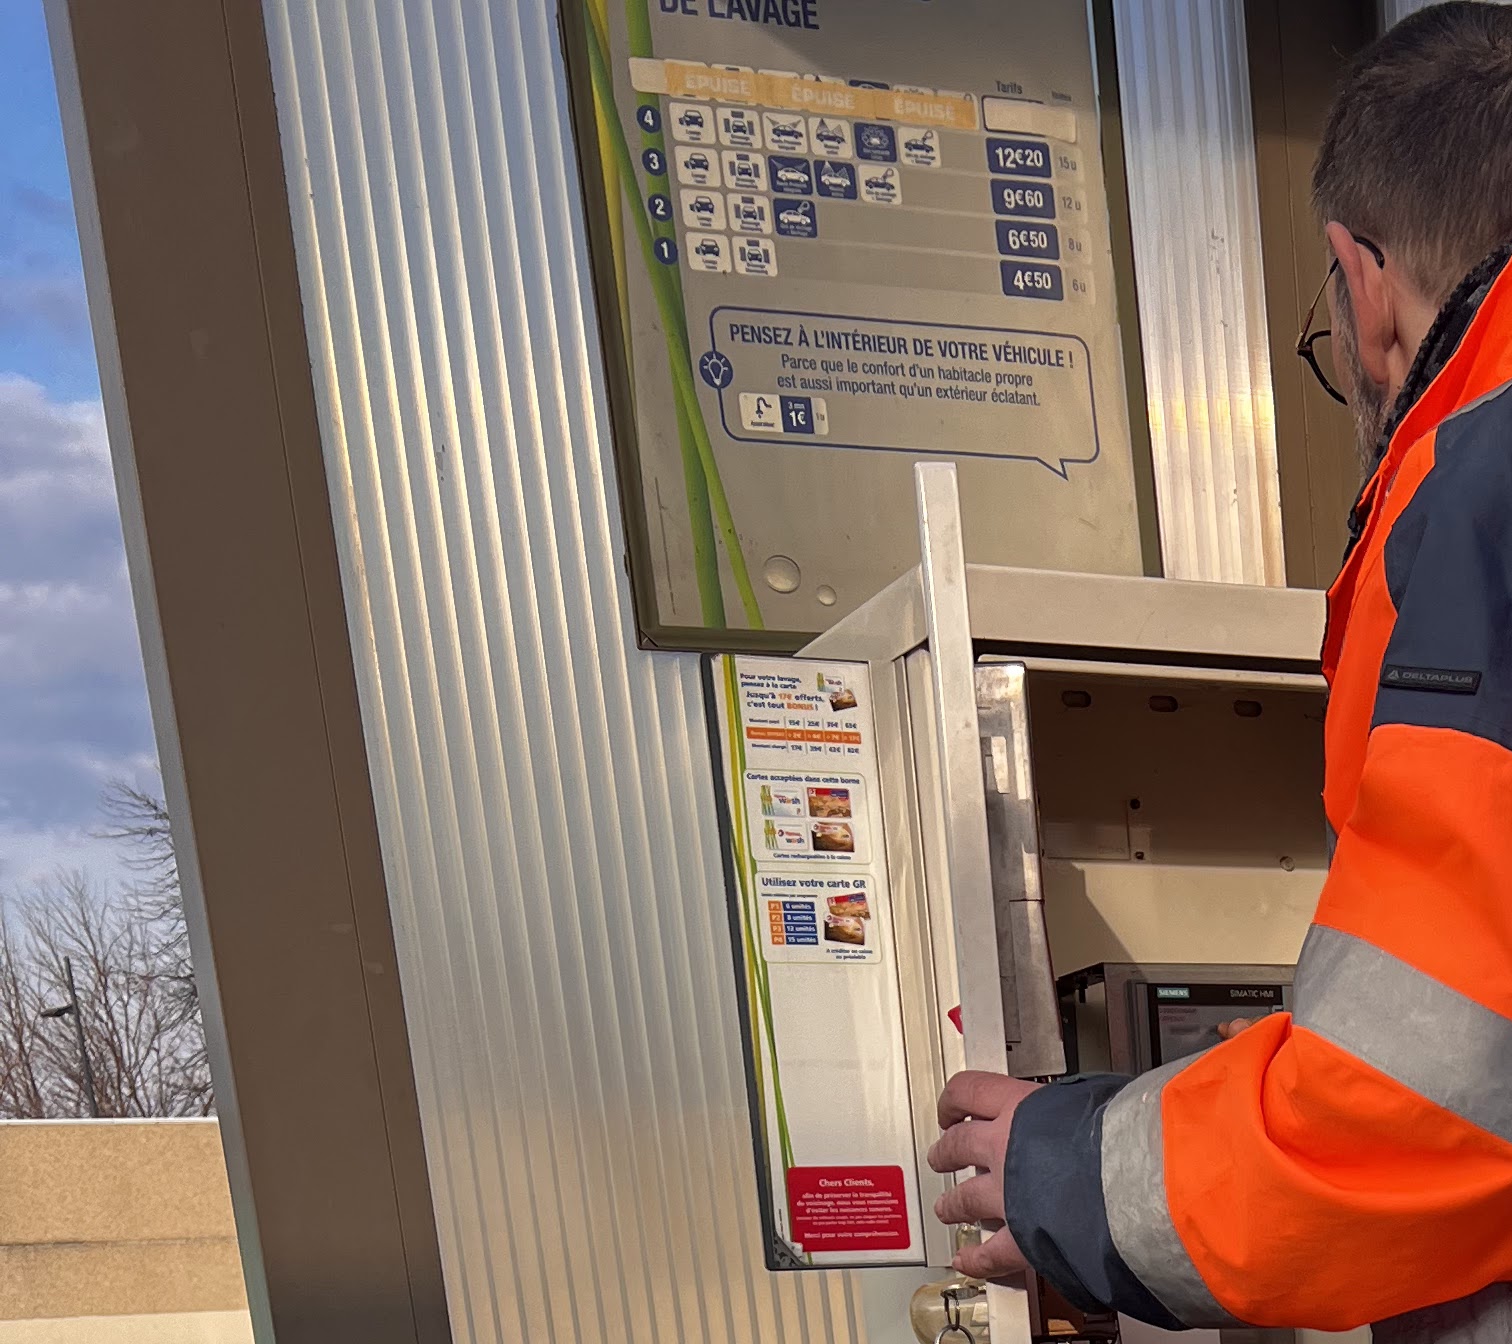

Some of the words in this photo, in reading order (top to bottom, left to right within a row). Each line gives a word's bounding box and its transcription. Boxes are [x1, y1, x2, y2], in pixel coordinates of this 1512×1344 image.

[708, 0, 819, 29] LAVAGE
[996, 80, 1022, 95] Tarifs
[644, 109, 653, 127] 4
[996, 147, 1044, 170] 12€20
[649, 153, 660, 171] 3
[1003, 188, 1044, 209] 9€60
[654, 198, 666, 215] 2
[1007, 229, 1048, 250] 6€50
[661, 241, 669, 258] 1
[1013, 270, 1052, 291] 4€50
[729, 323, 793, 346] PENSEZ
[798, 324, 809, 348] À
[813, 329, 909, 355] L'INTÉRIEUR
[912, 338, 934, 357] DE
[937, 340, 989, 361] VOTRE
[992, 341, 1064, 368] VÉHICULE
[781, 353, 817, 371] Parce
[820, 360, 844, 375] que
[847, 358, 858, 373] le
[862, 361, 906, 378] confort
[909, 362, 935, 379] d'un
[938, 365, 992, 384] habitacle
[995, 373, 1033, 389] propre
[777, 374, 797, 388] est
[800, 375, 832, 391] aussi
[836, 377, 896, 396] important
[900, 382, 932, 399] qu'un
[936, 385, 987, 402] extérieur
[991, 388, 1041, 406] éclatant.
[789, 411, 806, 427] 1€
[767, 701, 785, 709] tout
[747, 772, 768, 780] Cartes
[799, 879, 825, 888] votre
[827, 880, 850, 888] carte
[1230, 989, 1258, 998] SIMATIC
